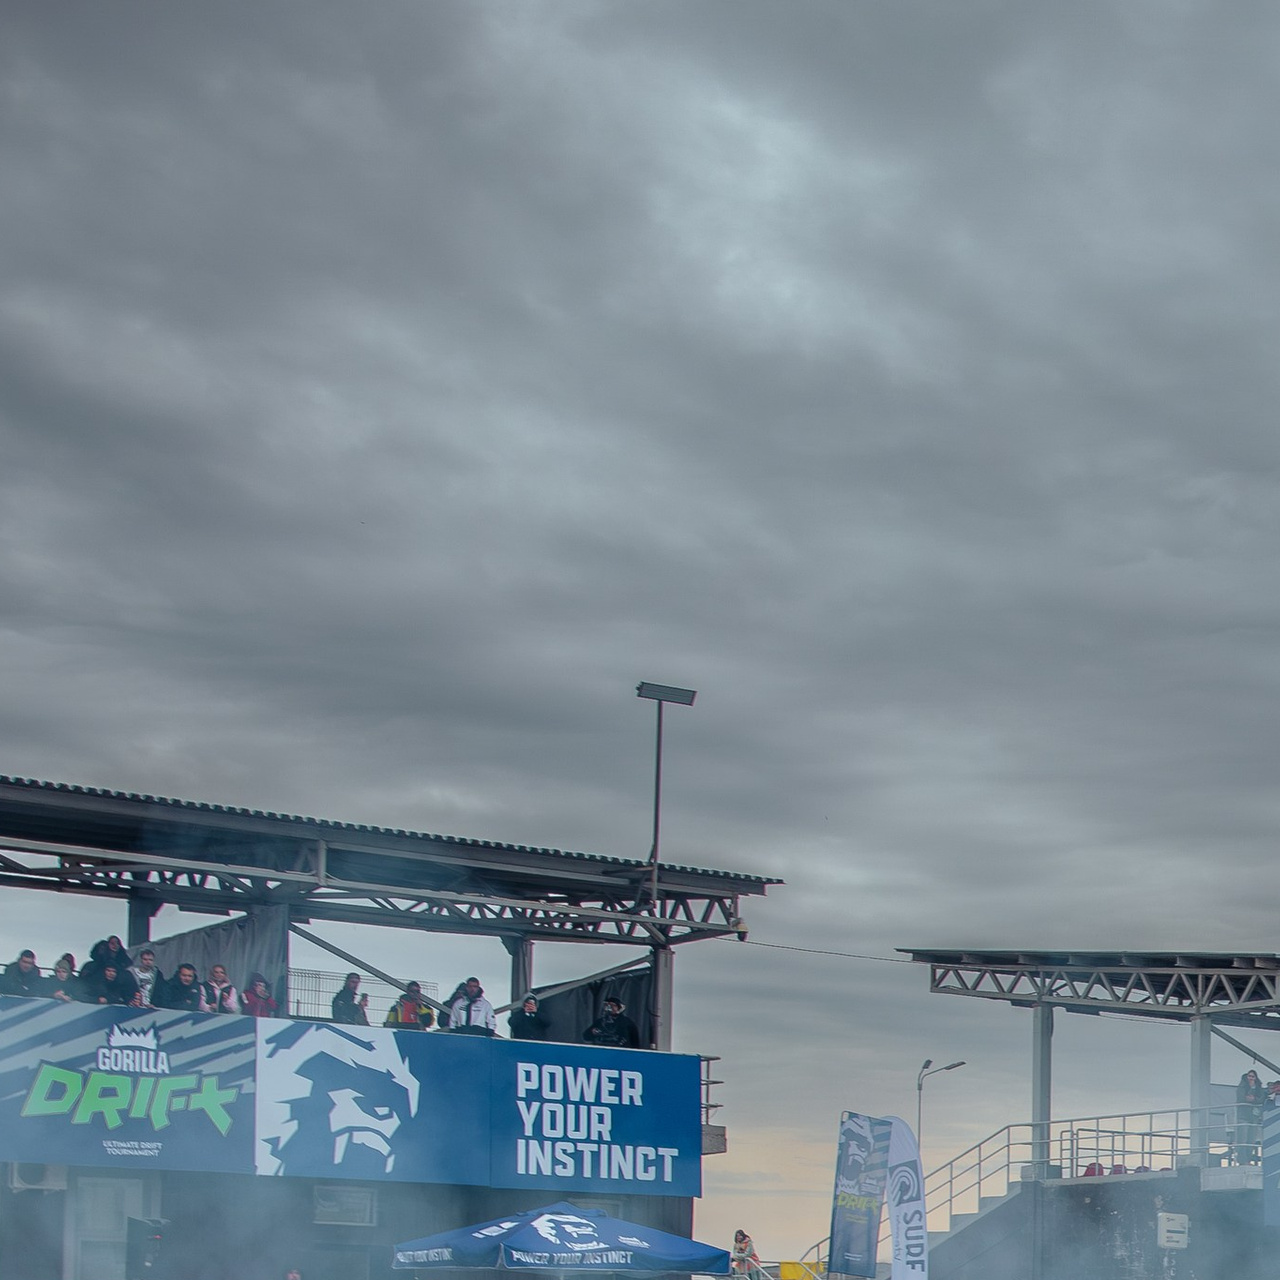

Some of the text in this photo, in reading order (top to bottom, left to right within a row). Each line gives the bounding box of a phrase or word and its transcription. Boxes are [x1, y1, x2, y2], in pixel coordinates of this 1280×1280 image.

[98, 1047, 170, 1075] GORILLA
[20, 1060, 240, 1137] DRIFT
[516, 1061, 643, 1106] POWER
[516, 1100, 613, 1142] YOUR
[516, 1139, 680, 1183] INSTINCT
[511, 1250, 634, 1265] POWER YOUR INSTINCT
